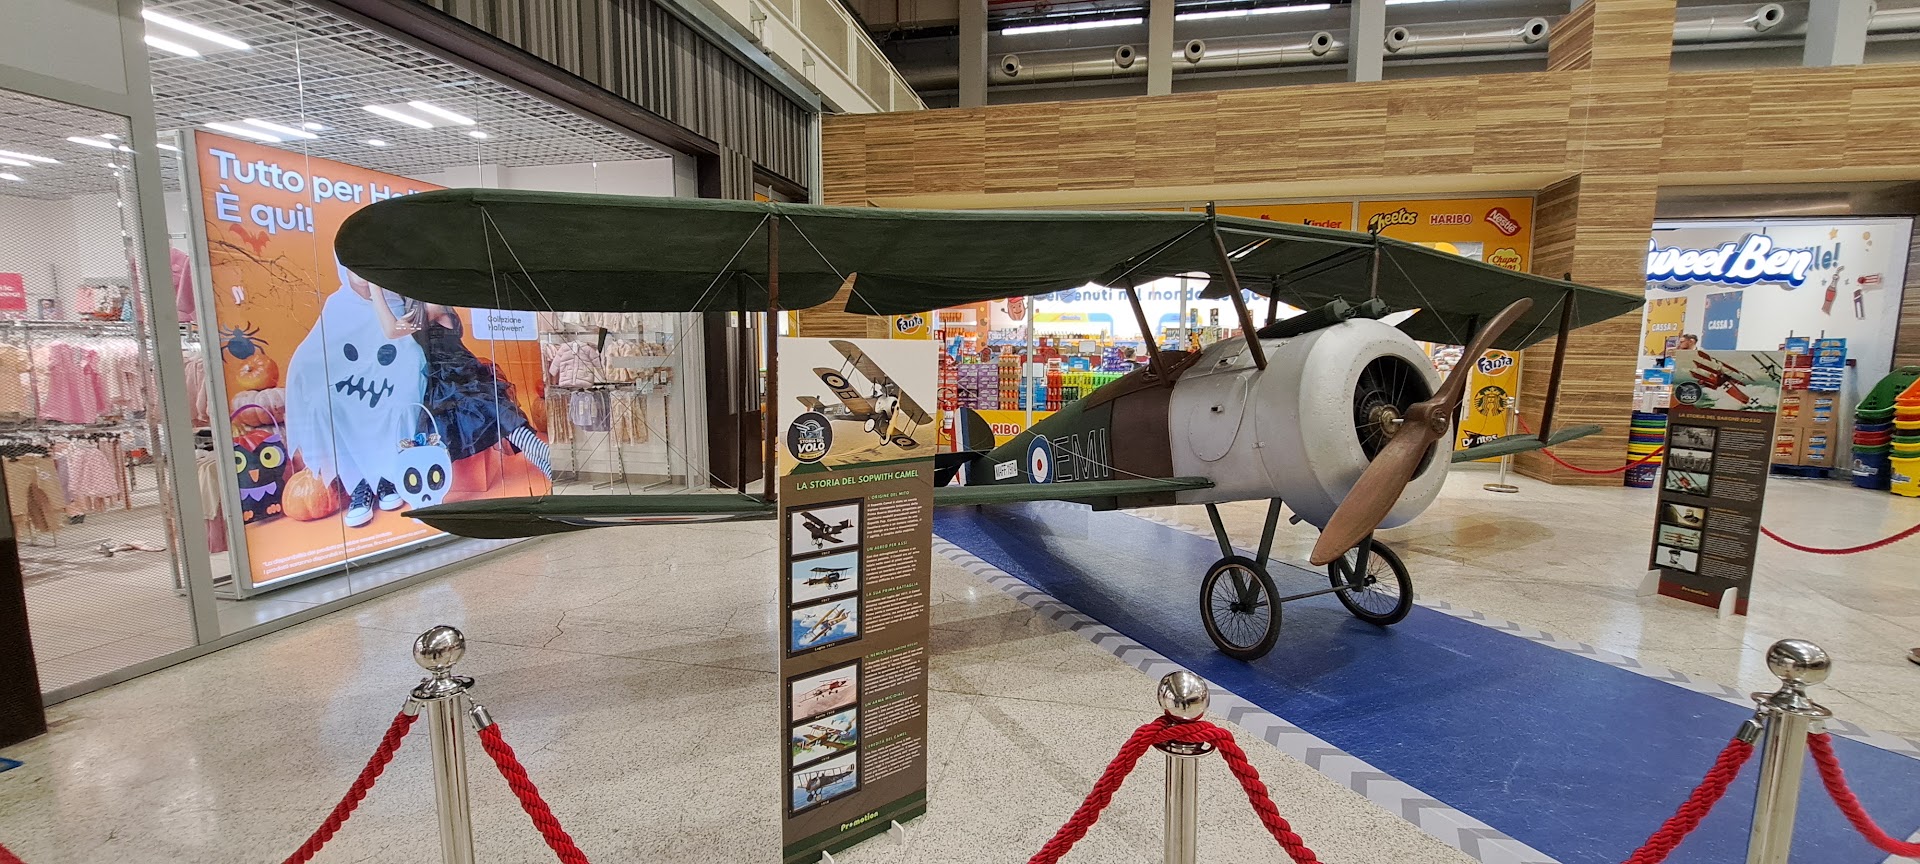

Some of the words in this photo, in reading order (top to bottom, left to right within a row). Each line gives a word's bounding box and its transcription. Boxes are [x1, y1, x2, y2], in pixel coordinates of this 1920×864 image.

[209, 148, 304, 193] Tutto
[312, 175, 363, 203] per
[215, 184, 242, 222] È
[250, 203, 314, 234] qui!
[1430, 214, 1472, 225] HARIBO
[1489, 210, 1517, 233] Nestlé
[1493, 255, 1518, 264] Chupa
[1726, 234, 1812, 281] Ben
[488, 316, 521, 324] Collezione
[896, 316, 923, 332] Fanta
[1652, 323, 1671, 332] CASSA
[1673, 323, 1678, 331] 2
[1709, 321, 1728, 330] CASSA
[1729, 320, 1734, 329] 3
[1478, 355, 1513, 373] Fanta
[992, 424, 1020, 435] RIBO
[797, 442, 825, 453] VOLO
[1053, 428, 1109, 482] EMI
[797, 482, 808, 491] LA
[810, 479, 840, 489] STORIA
[842, 477, 856, 486] DEL
[859, 473, 893, 484] SOPWITH
[895, 470, 919, 479] CAMEL
[840, 810, 879, 832] Promotion
